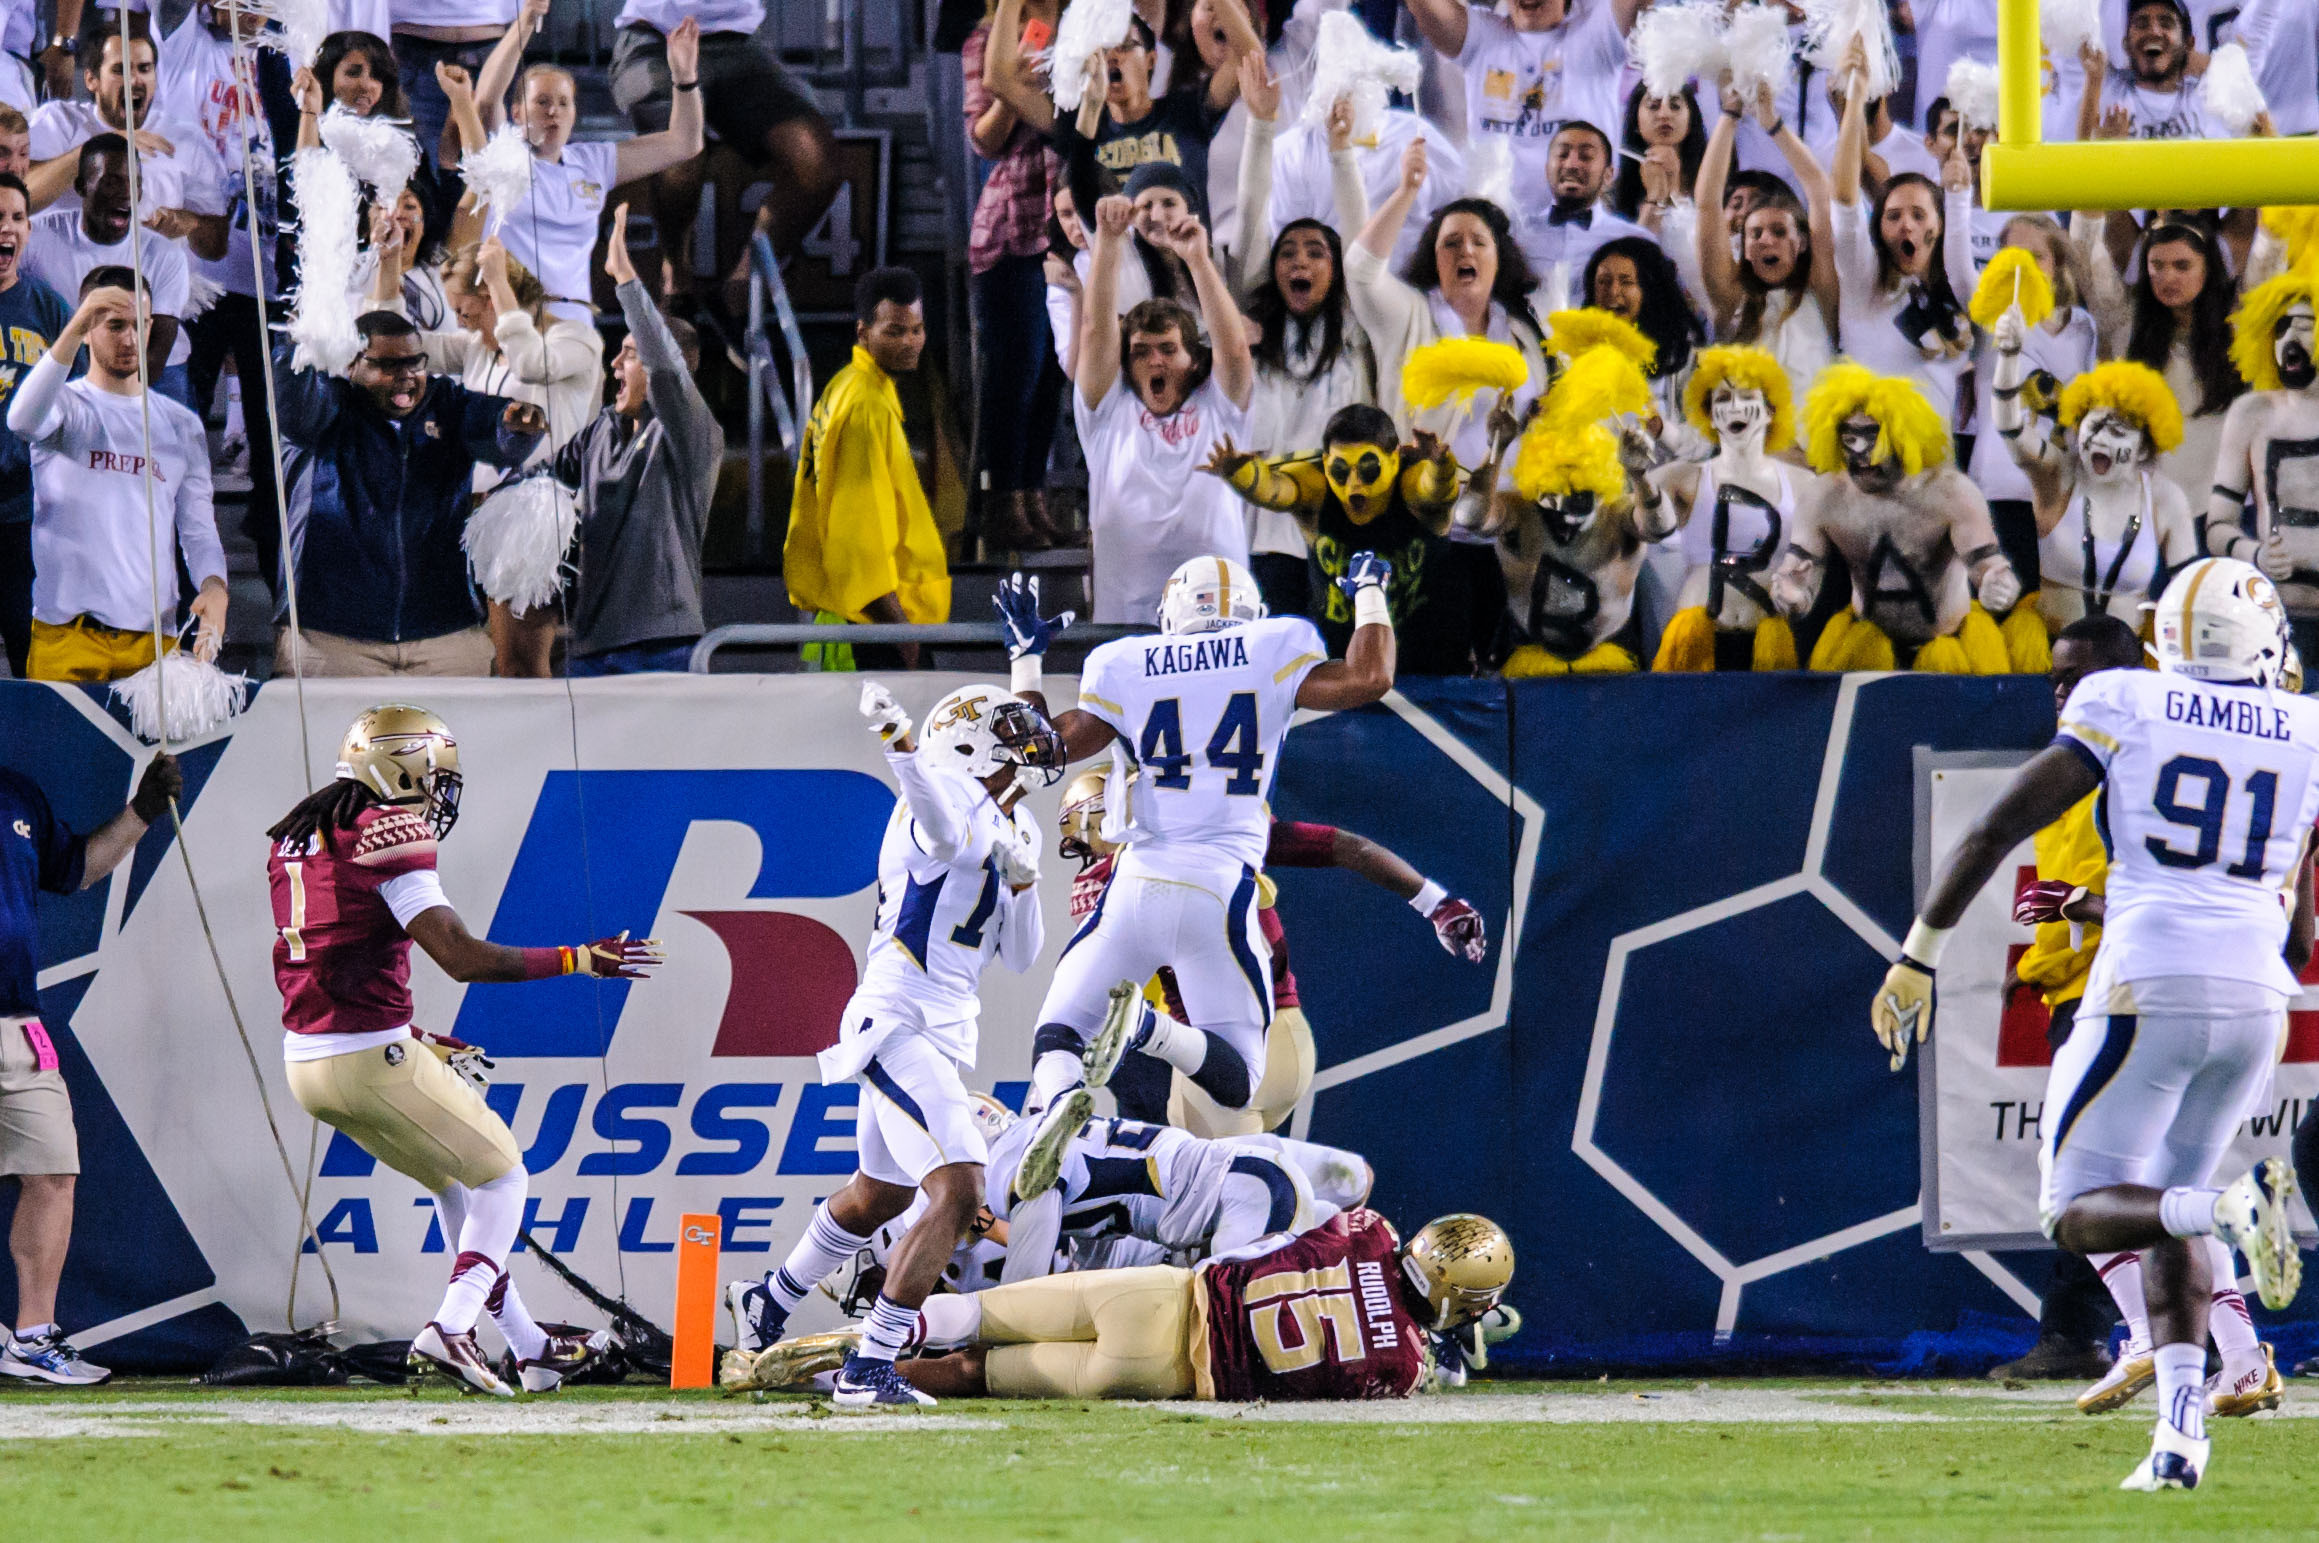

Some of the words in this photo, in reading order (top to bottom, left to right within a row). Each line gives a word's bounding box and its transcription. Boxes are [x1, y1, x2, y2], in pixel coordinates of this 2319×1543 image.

[693, 180, 861, 277] 14
[1144, 636, 1249, 677] KAGAWA
[1140, 689, 1265, 798] 44
[2166, 690, 2291, 742] GAMBLE
[2144, 753, 2279, 882] 91
[1243, 1255, 1366, 1375] 15
[1356, 1261, 1397, 1350] RUDOLPH
[2233, 1368, 2259, 1397] NIKE
